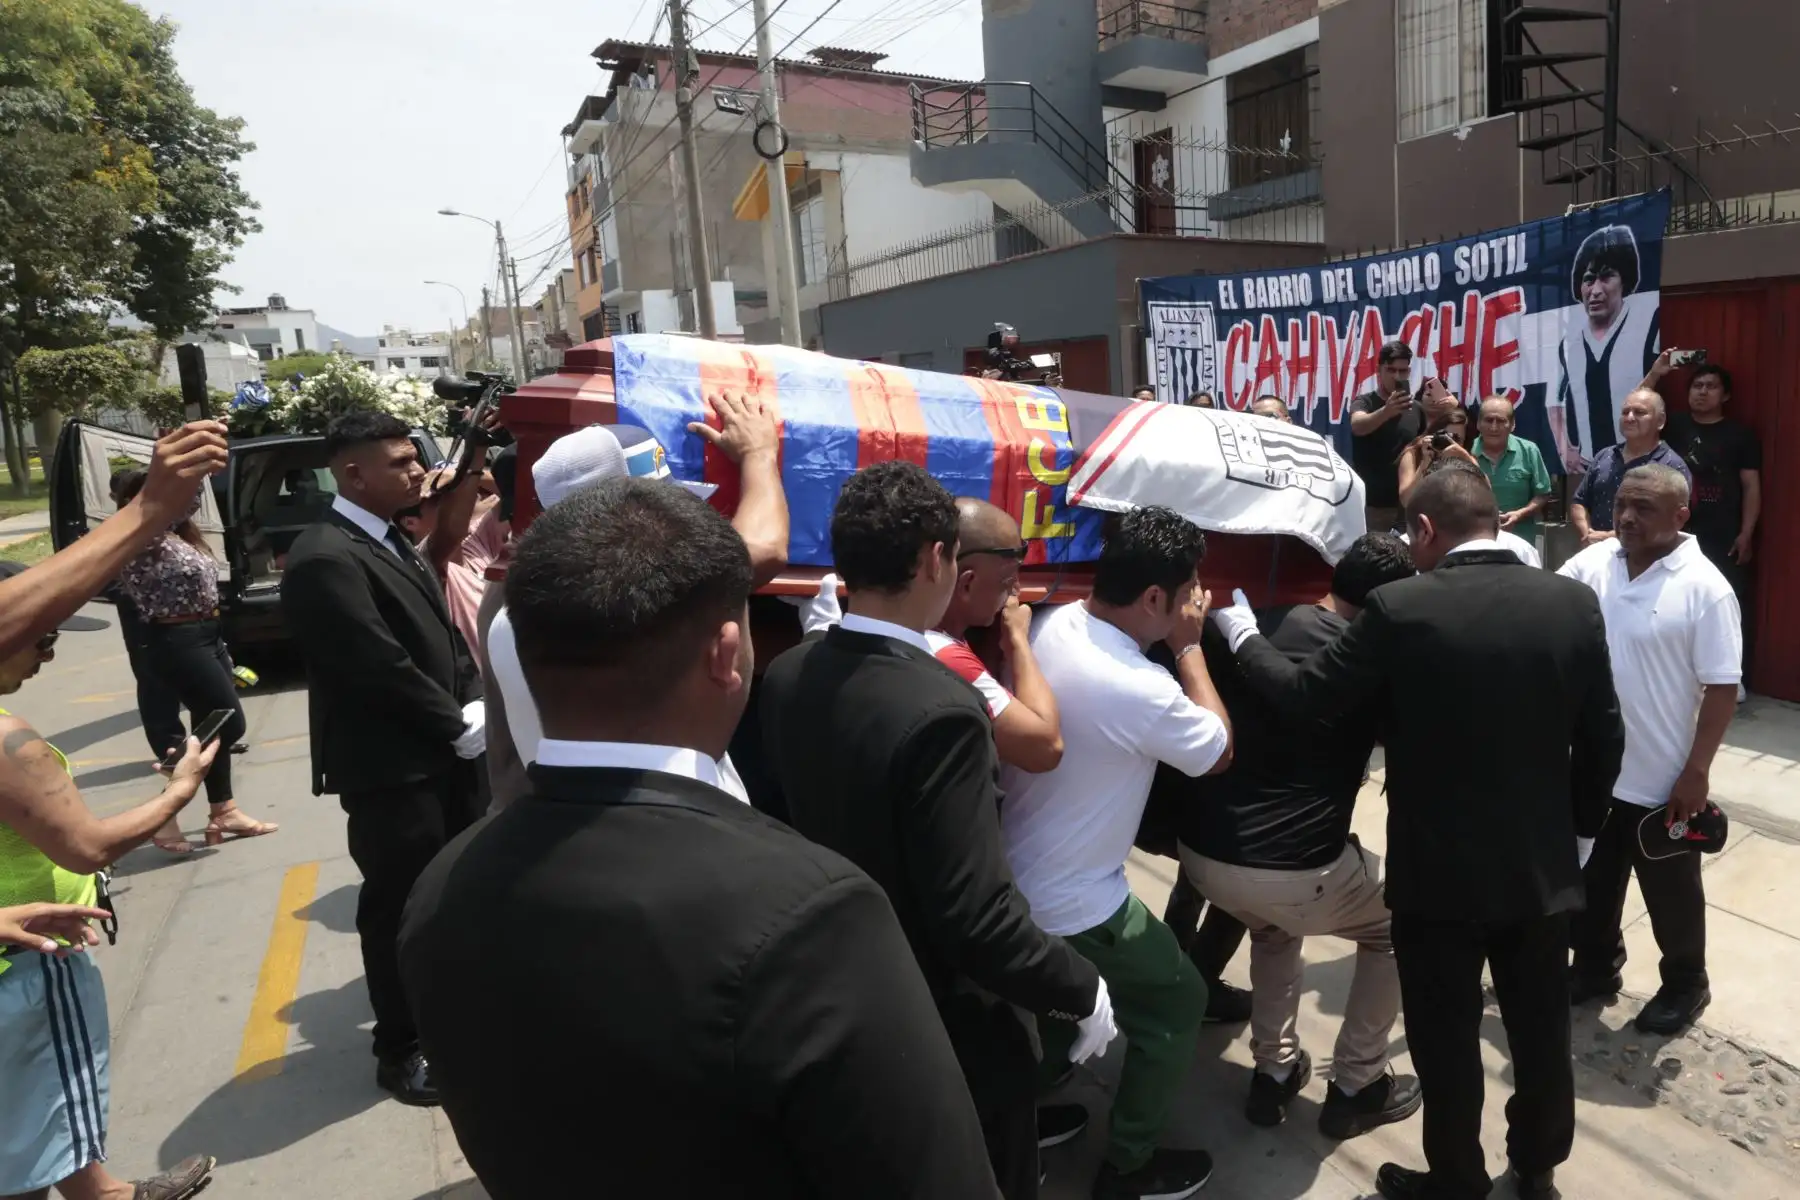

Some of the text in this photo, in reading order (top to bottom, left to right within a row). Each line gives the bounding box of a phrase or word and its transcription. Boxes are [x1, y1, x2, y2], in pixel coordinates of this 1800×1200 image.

[1218, 232, 1528, 310] EL BARRIO DEL CHOLO SOTIL
[1160, 310, 1206, 322] ALIANZA
[1157, 339, 1167, 388] CLUB
[1203, 344, 1214, 392] LIMA
